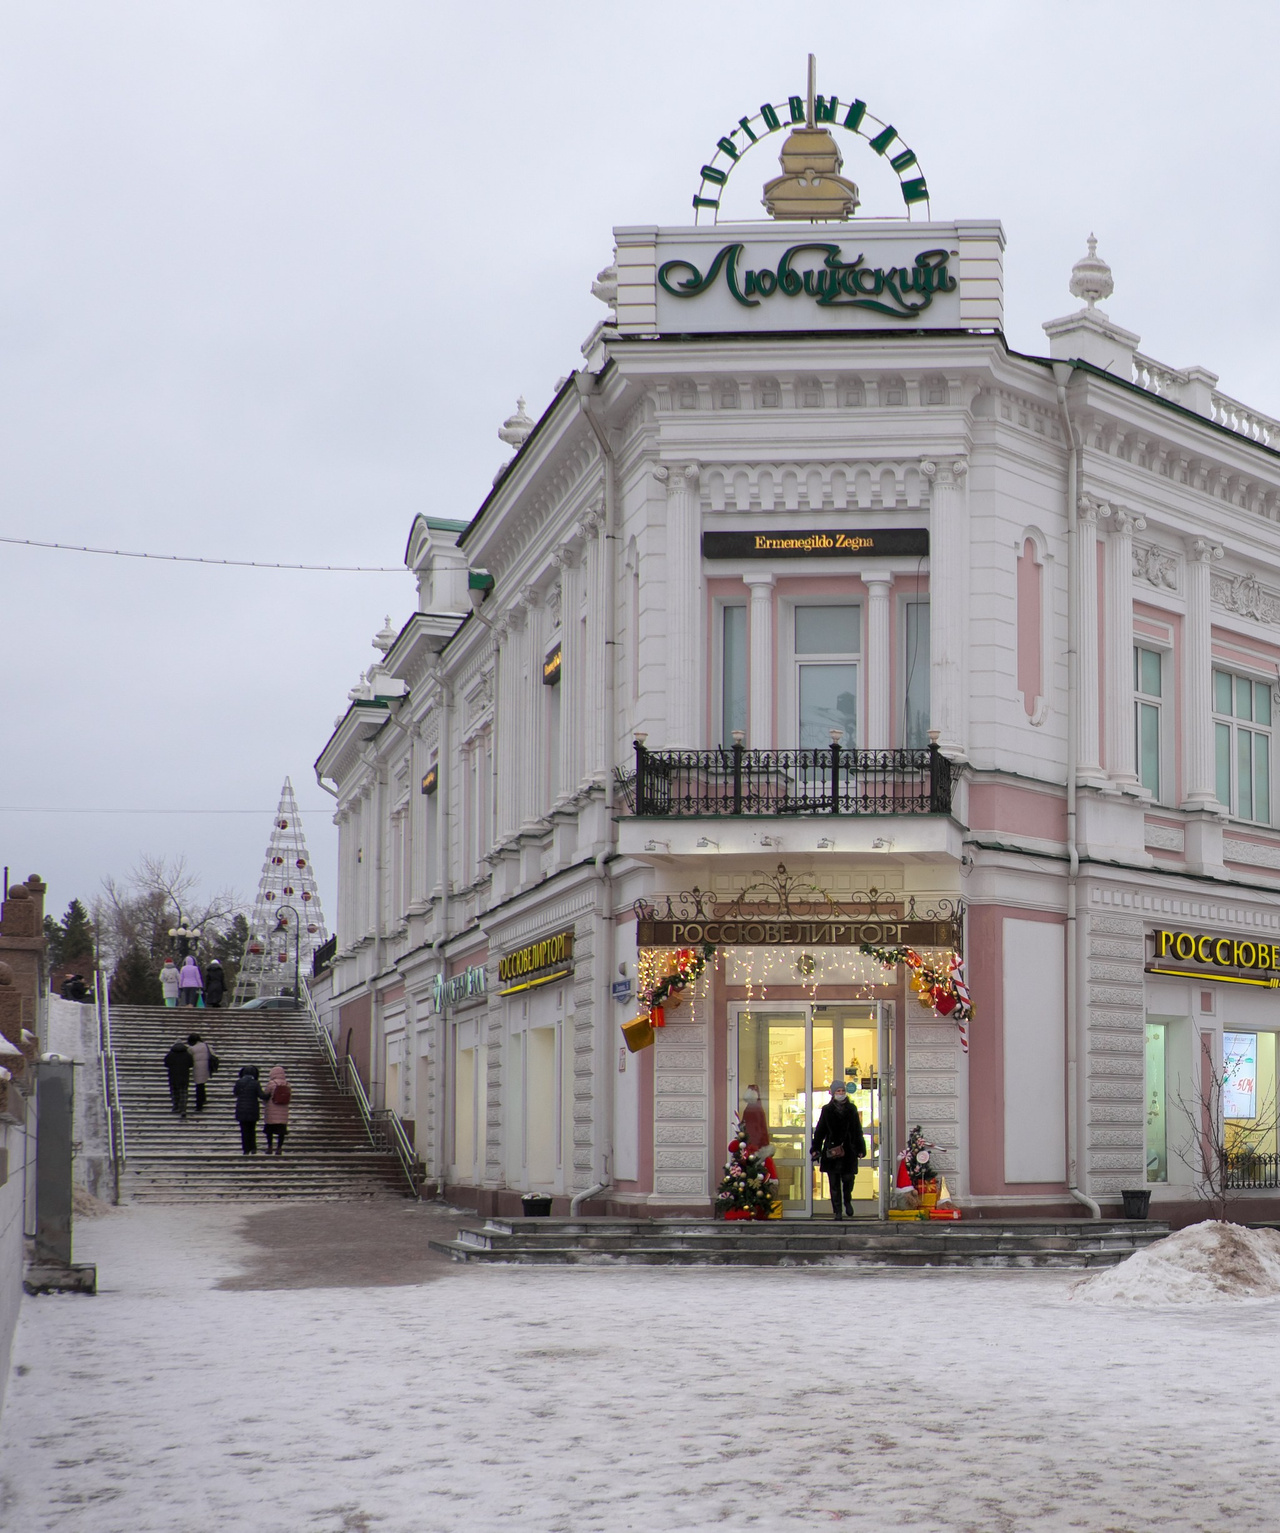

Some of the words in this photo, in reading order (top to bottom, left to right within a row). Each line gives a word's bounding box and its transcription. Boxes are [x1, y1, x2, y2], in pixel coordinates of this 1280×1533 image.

[693, 94, 867, 208] ТОРГОВЫЙ
[869, 124, 930, 204] ДОМ
[658, 243, 957, 318] Любинский
[754, 535, 834, 552] Ermenegildo
[835, 534, 874, 550] Zegna
[672, 923, 910, 945] РОССЮВЕЛИРТОРГ
